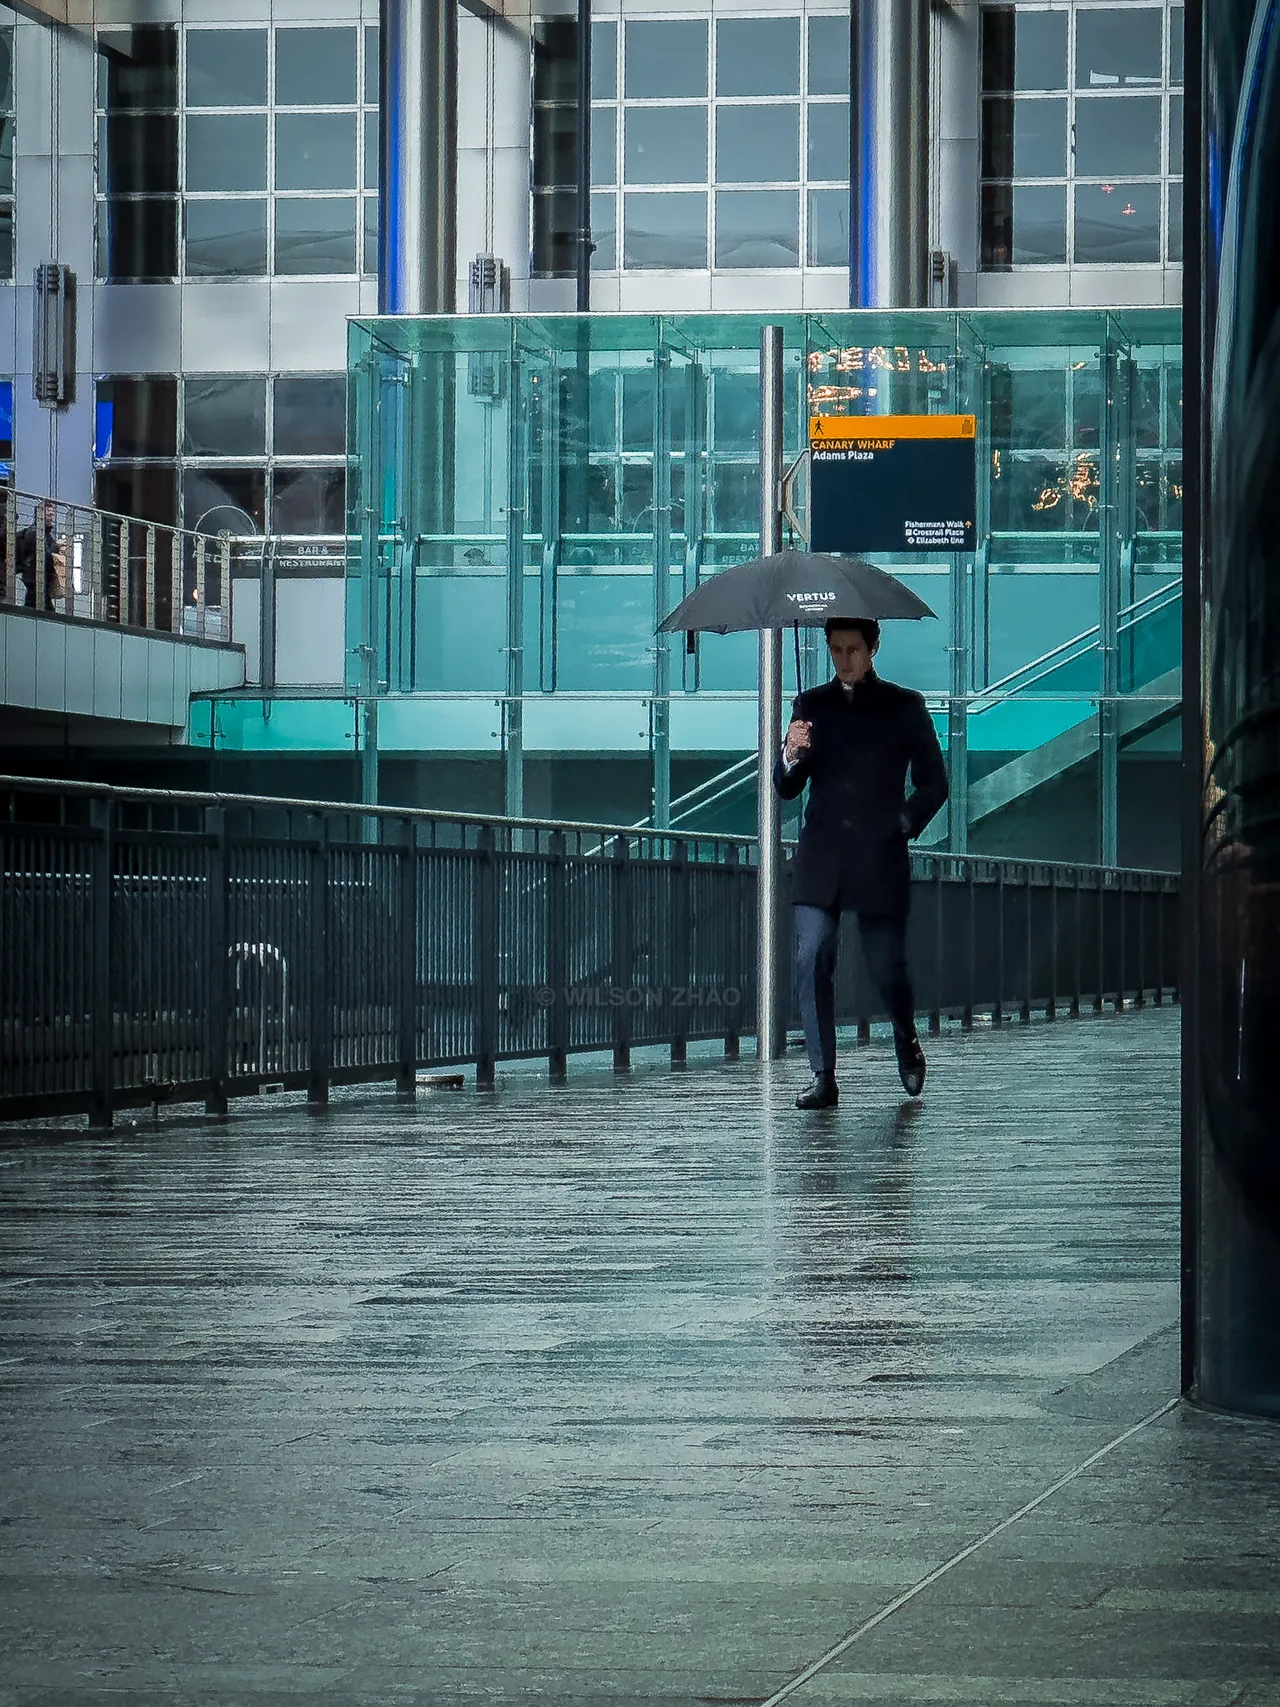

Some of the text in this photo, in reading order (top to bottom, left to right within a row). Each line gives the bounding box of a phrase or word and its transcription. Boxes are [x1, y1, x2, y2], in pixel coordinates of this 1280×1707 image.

[811, 440, 895, 449] CANARY WHARF
[812, 451, 874, 460] Adams Plaza
[298, 546, 320, 555] BAR
[786, 592, 837, 602] VERTUS
